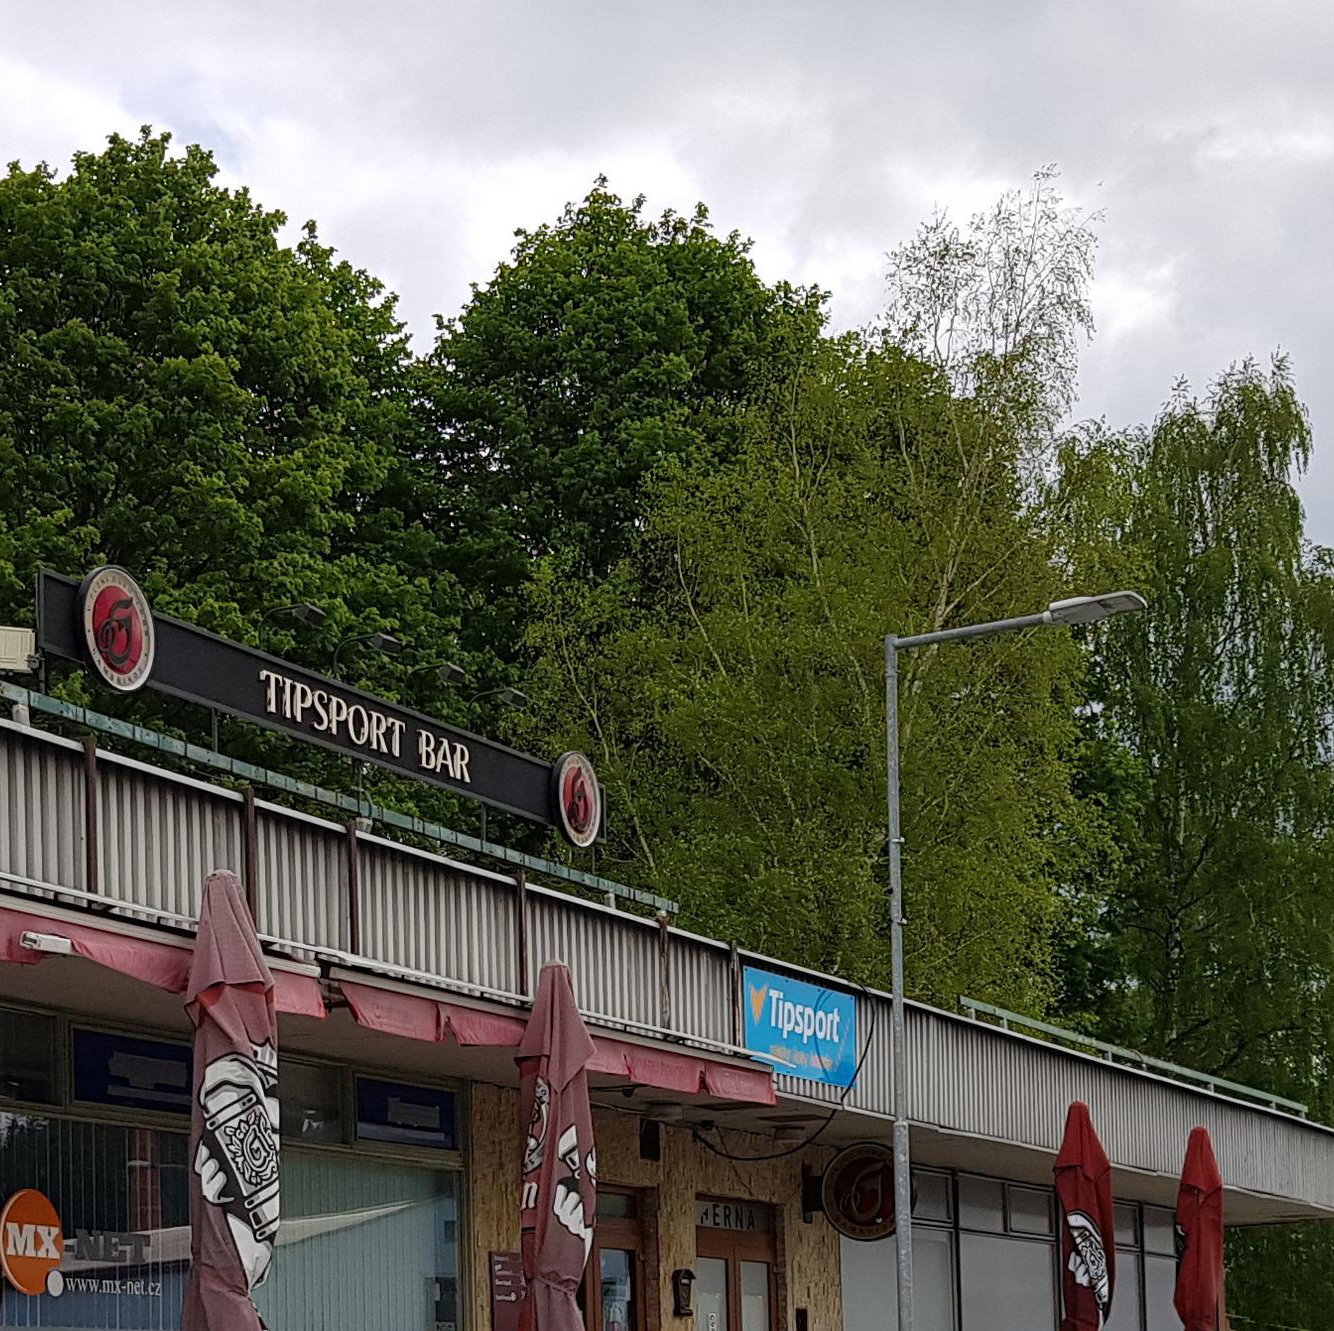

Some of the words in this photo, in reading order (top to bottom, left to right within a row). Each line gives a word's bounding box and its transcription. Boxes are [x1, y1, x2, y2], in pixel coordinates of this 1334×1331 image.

[259, 669, 407, 758] TIPSPORT
[417, 729, 472, 784] BAR
[769, 988, 841, 1045] Tipsport
[65, 1277, 163, 1298] www.mx-net.cz
